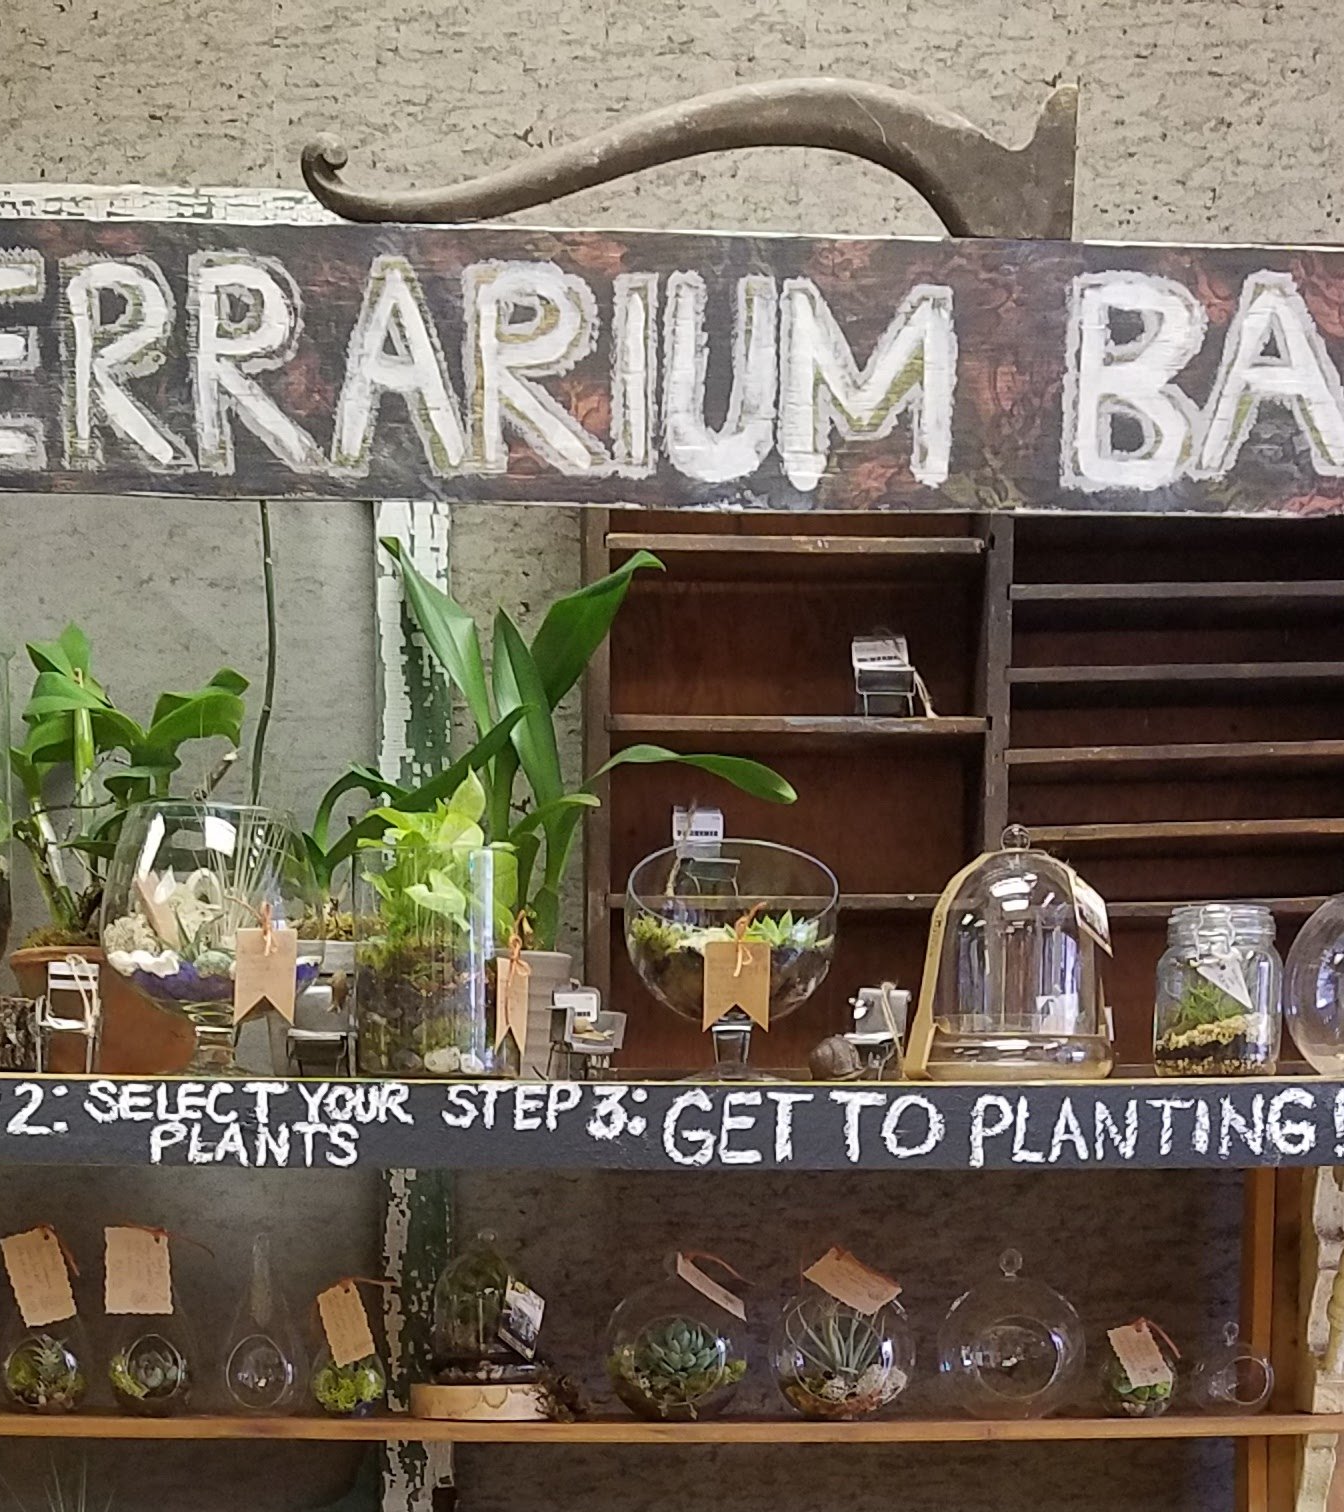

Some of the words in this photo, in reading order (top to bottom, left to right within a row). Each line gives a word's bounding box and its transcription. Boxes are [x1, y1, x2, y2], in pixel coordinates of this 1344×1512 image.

[6, 1083, 70, 1136] 2:
[83, 1080, 290, 1125] SELECT
[296, 1082, 414, 1126] YOUR
[441, 1083, 583, 1132] STEP
[586, 1085, 649, 1141] 3:
[662, 1087, 815, 1167] GET
[829, 1090, 947, 1163] TO
[150, 1121, 360, 1168] PLANTS
